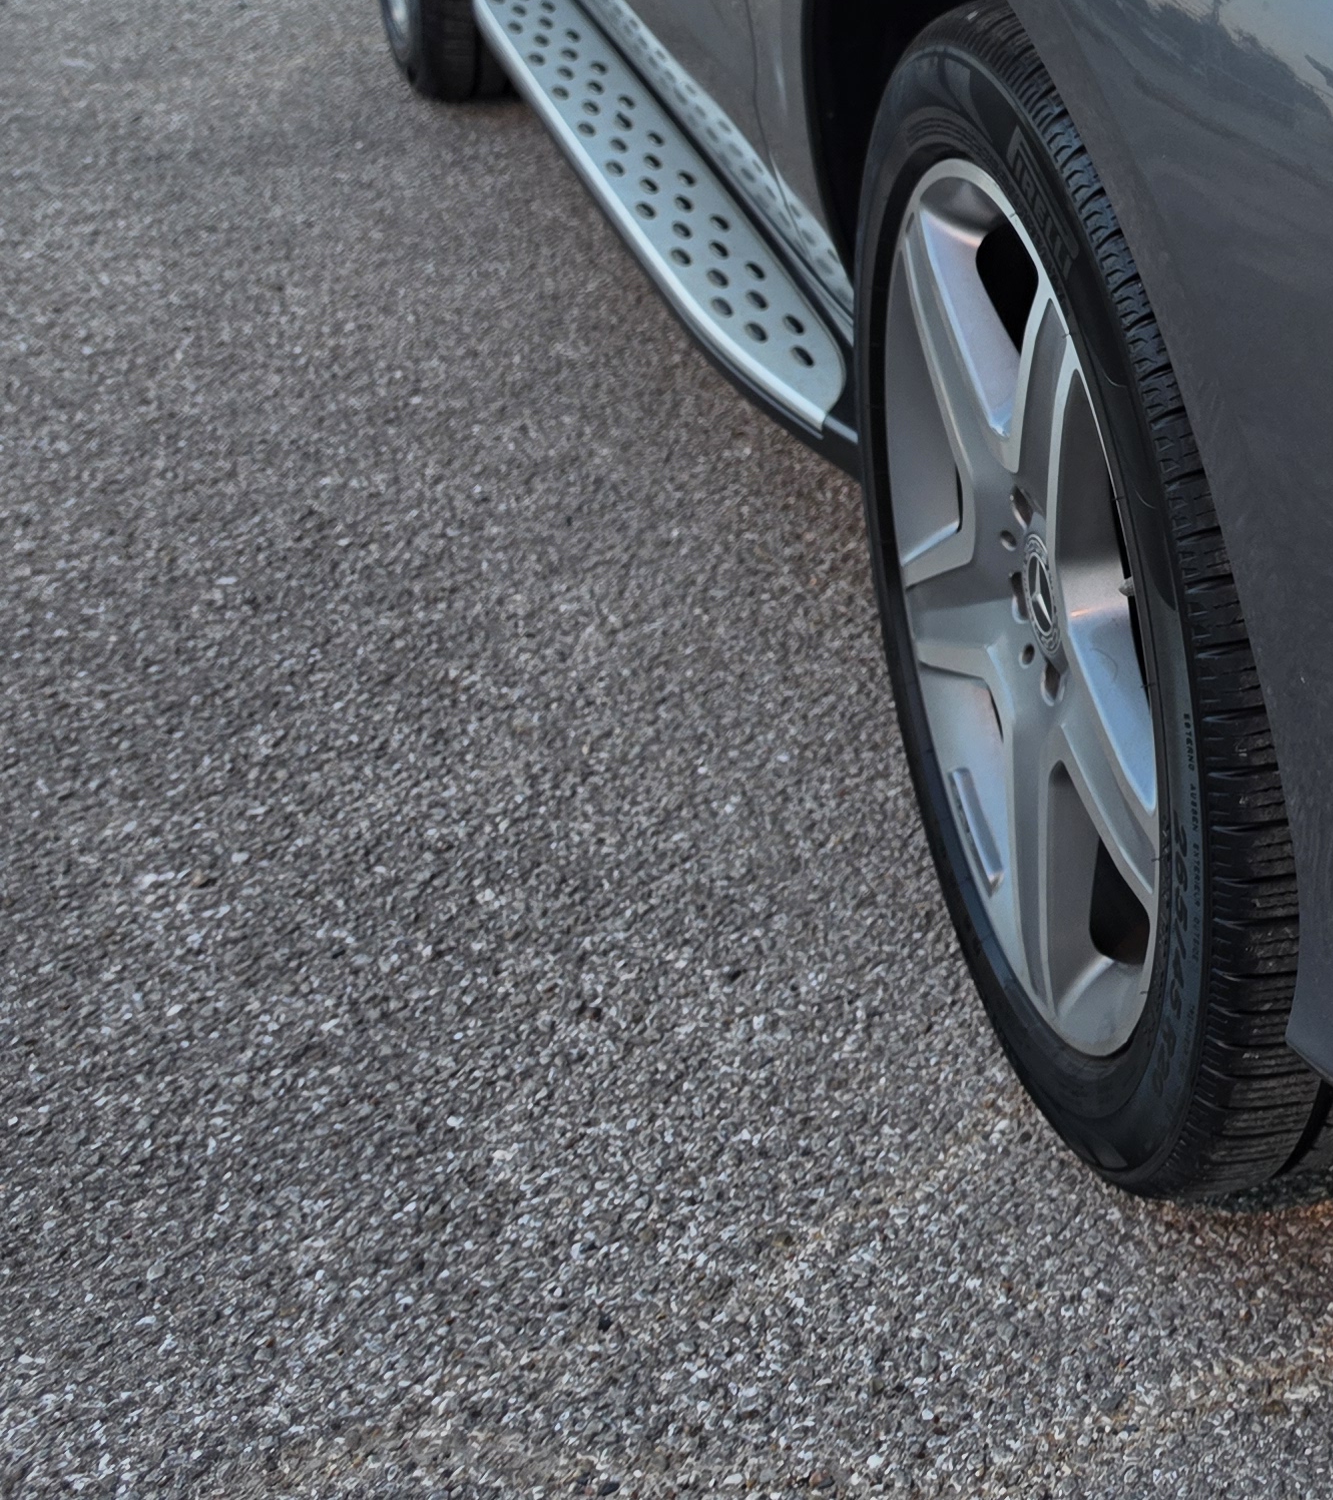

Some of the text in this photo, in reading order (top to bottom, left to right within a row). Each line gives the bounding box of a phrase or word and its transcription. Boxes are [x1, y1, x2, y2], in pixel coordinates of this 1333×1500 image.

[1006, 124, 1080, 282] PIRELLI
[1171, 810, 1188, 1014] 265/45
[1152, 1017, 1177, 1099] R20
